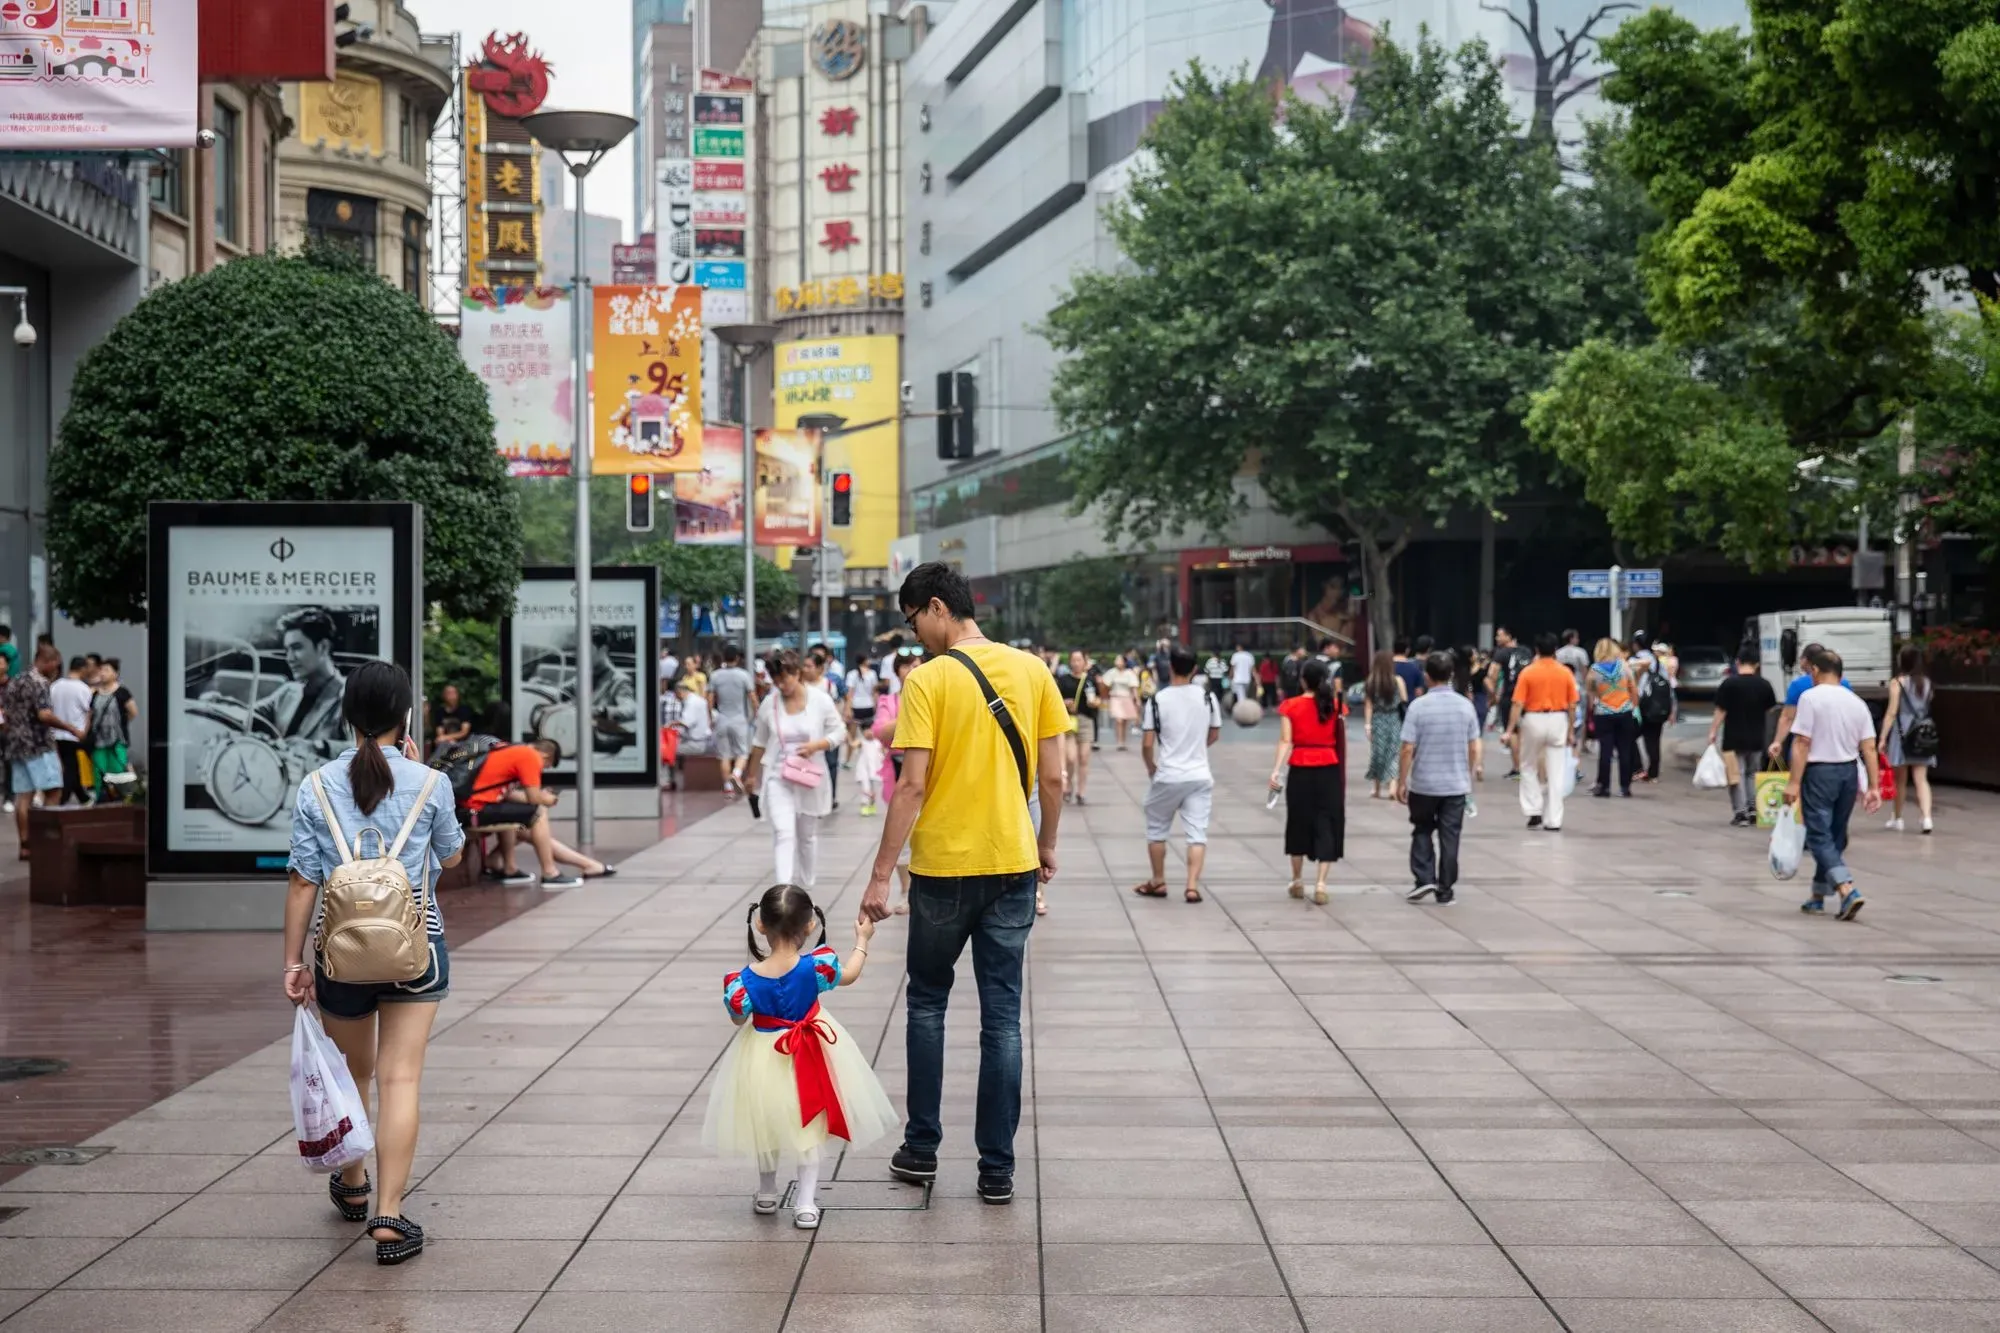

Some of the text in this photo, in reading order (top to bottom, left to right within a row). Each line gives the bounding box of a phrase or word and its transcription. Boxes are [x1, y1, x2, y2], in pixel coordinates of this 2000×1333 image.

[818, 106, 861, 255] 新世界
[489, 322, 543, 339] 热烈庆祝
[482, 343, 549, 360] 中国共产党
[481, 361, 552, 380] 成立95周年
[647, 361, 685, 403] 95
[187, 571, 376, 586] BAUME & MERCIER
